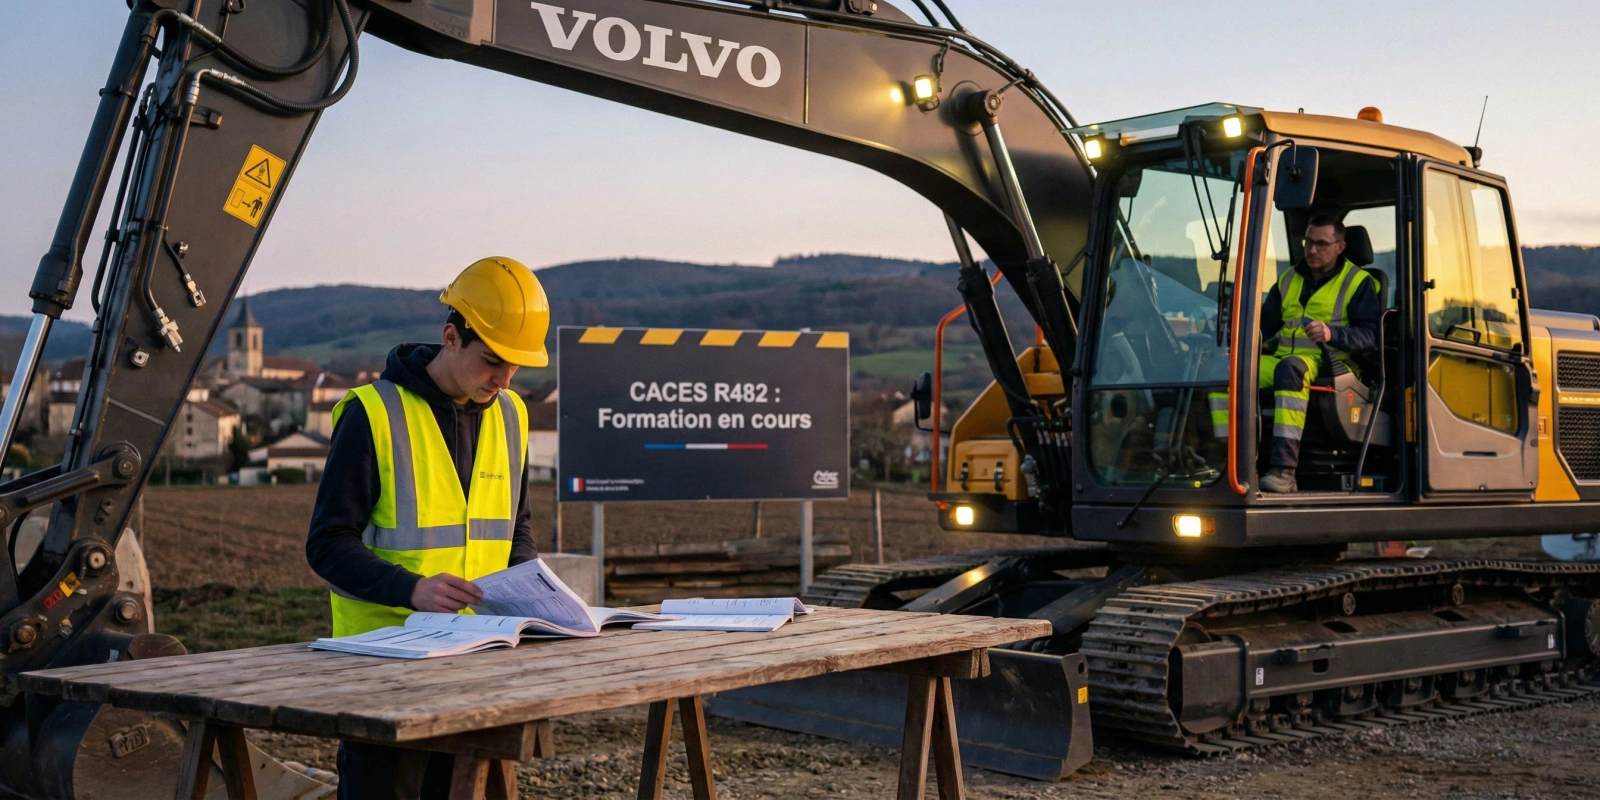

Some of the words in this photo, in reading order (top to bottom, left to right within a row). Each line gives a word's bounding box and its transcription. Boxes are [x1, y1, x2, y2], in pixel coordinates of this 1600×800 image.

[530, 1, 782, 88] VOLVO
[629, 381, 708, 403] CACES
[714, 382, 768, 403] R482
[598, 408, 712, 429] Formation
[717, 413, 745, 429] en
[751, 413, 812, 429] cours
